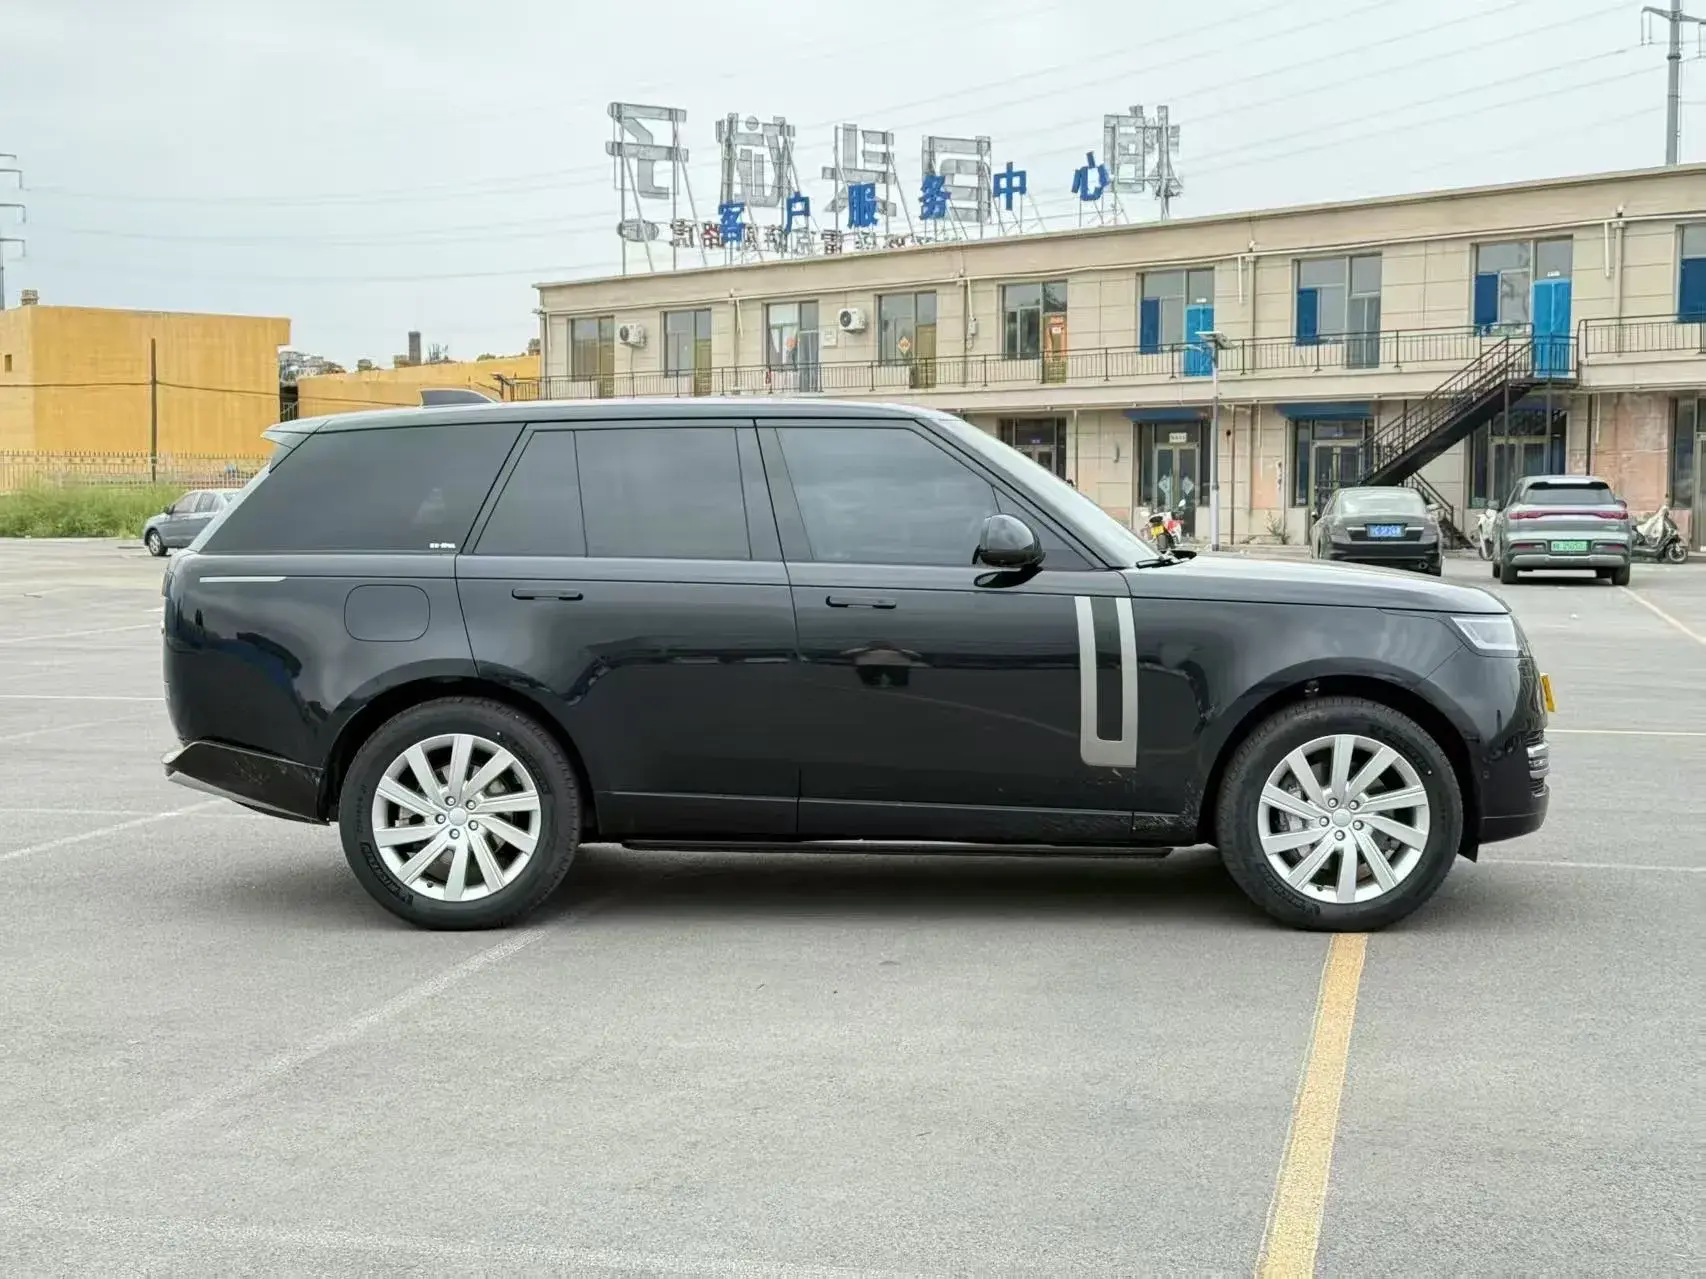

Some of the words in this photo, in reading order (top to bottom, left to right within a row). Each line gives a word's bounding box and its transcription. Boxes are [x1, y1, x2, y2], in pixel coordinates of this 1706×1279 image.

[718, 151, 1110, 247] 客户服务中心
